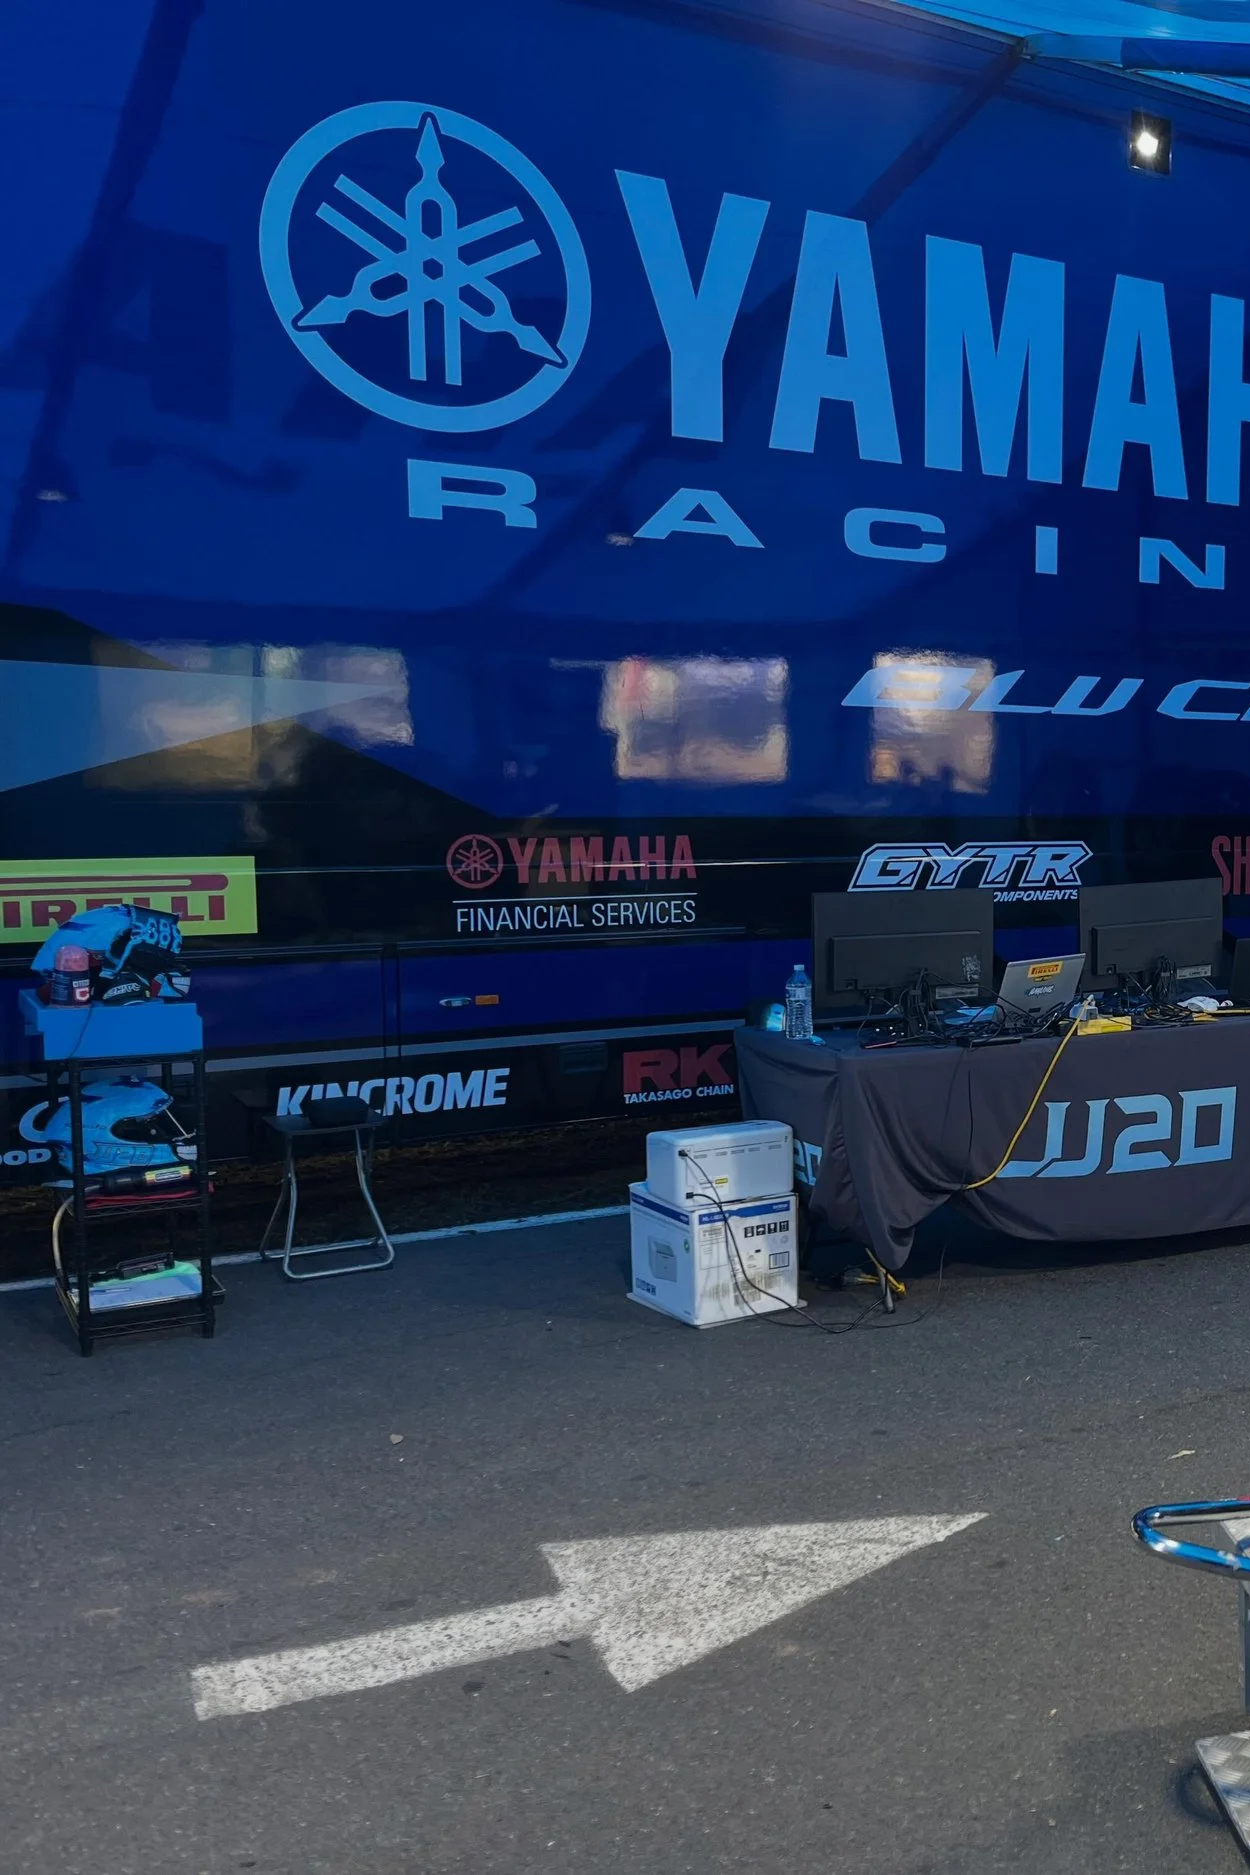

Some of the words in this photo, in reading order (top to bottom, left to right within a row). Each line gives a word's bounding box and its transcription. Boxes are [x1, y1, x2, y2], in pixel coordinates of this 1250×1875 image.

[841, 665, 1144, 717] BLU
[507, 835, 697, 884] YAMAHA
[848, 841, 1093, 892] GYTR
[456, 904, 584, 932] FINANCIAL
[592, 900, 696, 927] SERVICES
[623, 1044, 734, 1094] RK
[624, 1088, 692, 1104] TAKASAGO
[696, 1084, 734, 1097] CHAIN
